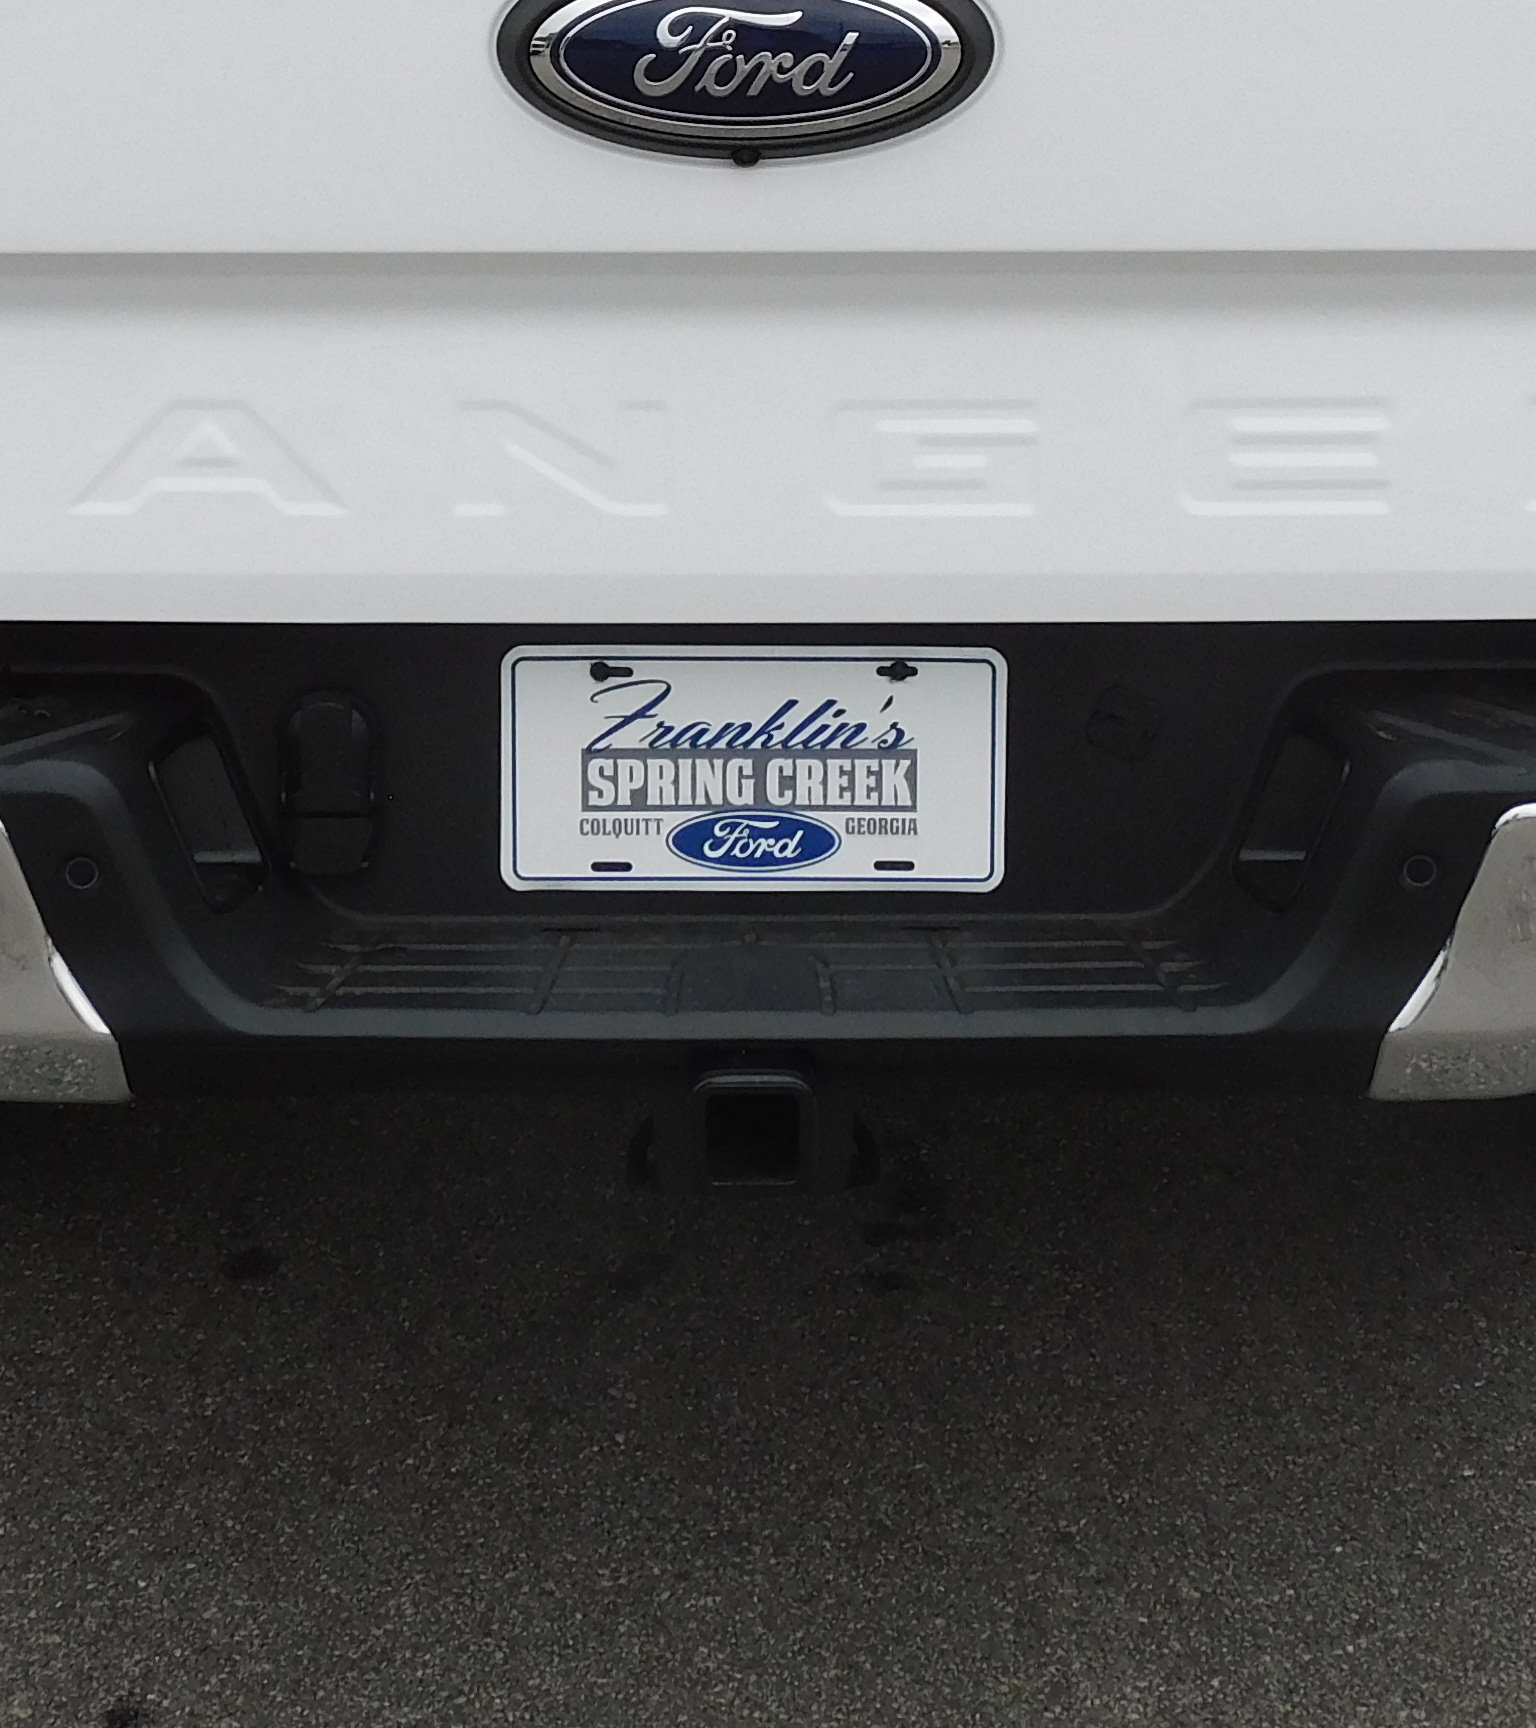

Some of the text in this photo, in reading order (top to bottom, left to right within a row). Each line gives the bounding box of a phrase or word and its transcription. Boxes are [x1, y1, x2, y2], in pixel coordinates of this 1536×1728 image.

[632, 5, 860, 99] Ford
[585, 678, 915, 754] Franklin's
[587, 757, 913, 807] SPRING CREEK
[579, 817, 664, 840] COLQUITT
[702, 817, 803, 861] Ford
[844, 817, 919, 837] GEORGIA
